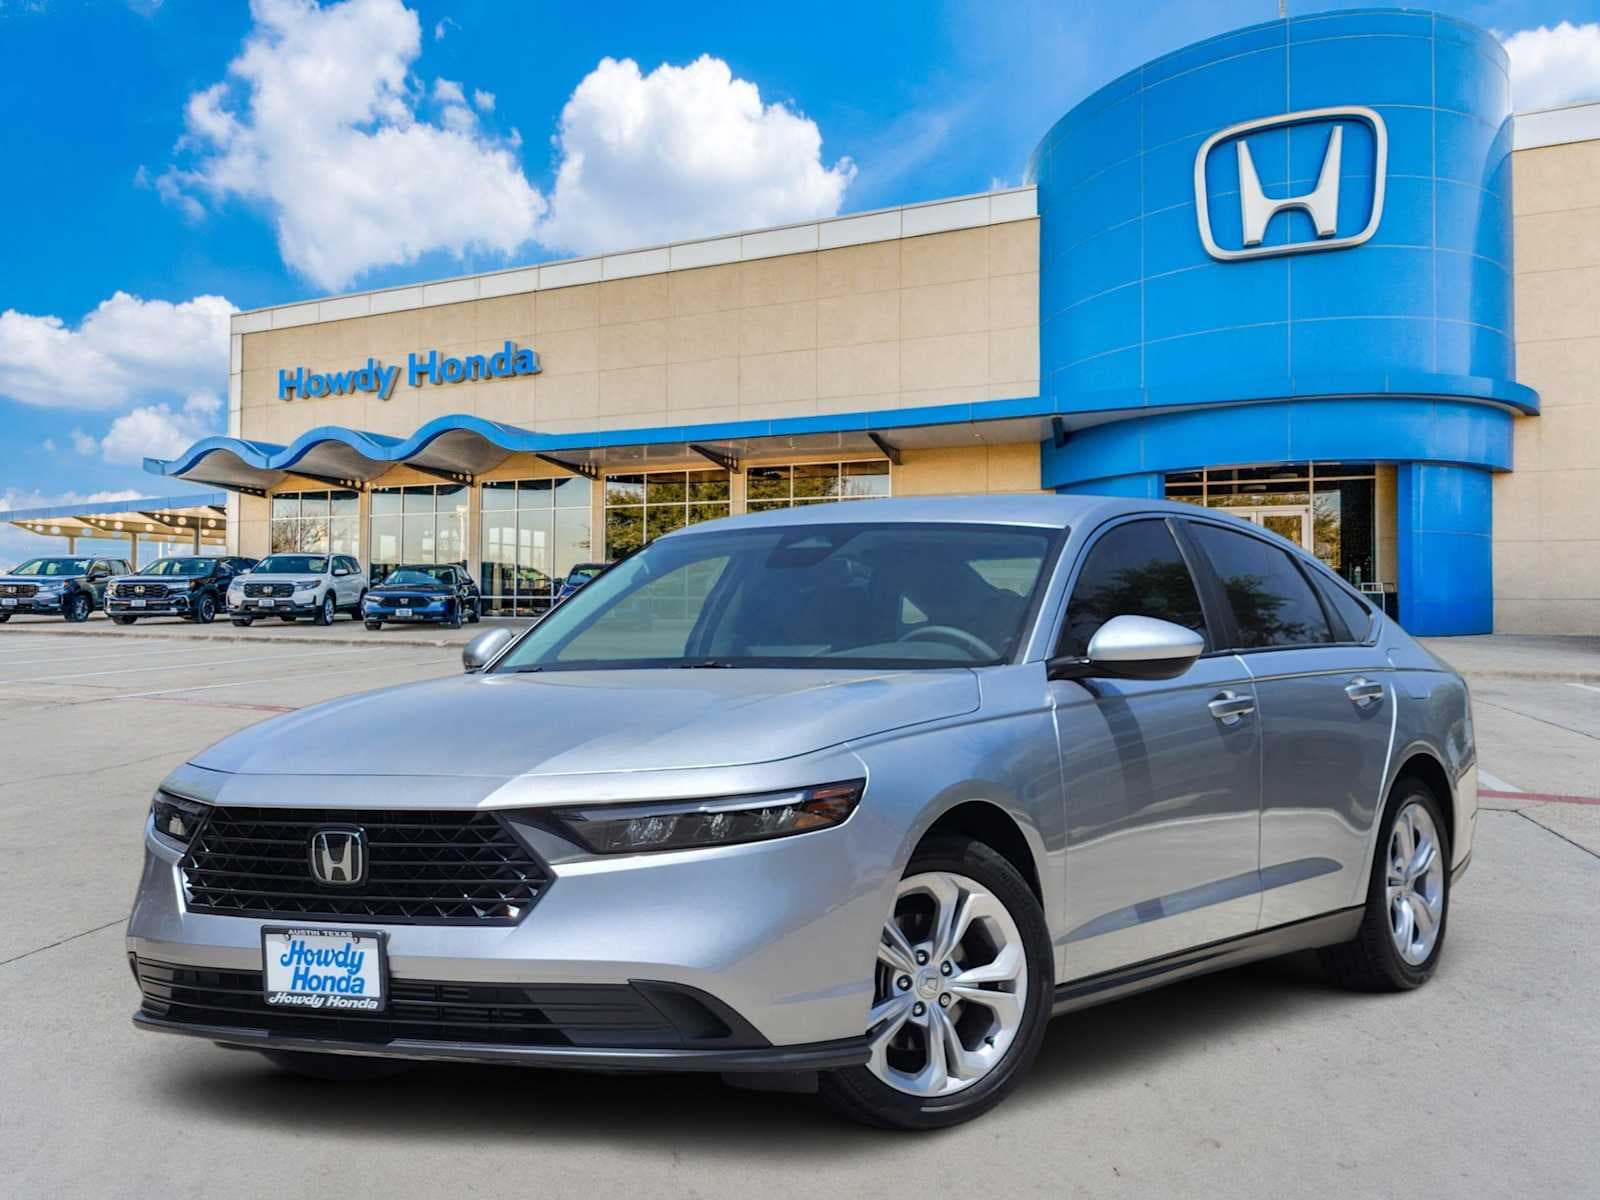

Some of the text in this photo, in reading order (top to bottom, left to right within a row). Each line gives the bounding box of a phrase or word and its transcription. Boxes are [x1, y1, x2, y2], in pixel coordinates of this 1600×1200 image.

[278, 340, 541, 400] Howdy Honda
[288, 929, 353, 938] AUSTIN TEXAS
[280, 940, 365, 975] Howdy
[290, 966, 365, 994] Honda
[269, 992, 378, 1009] Howdy Honda
